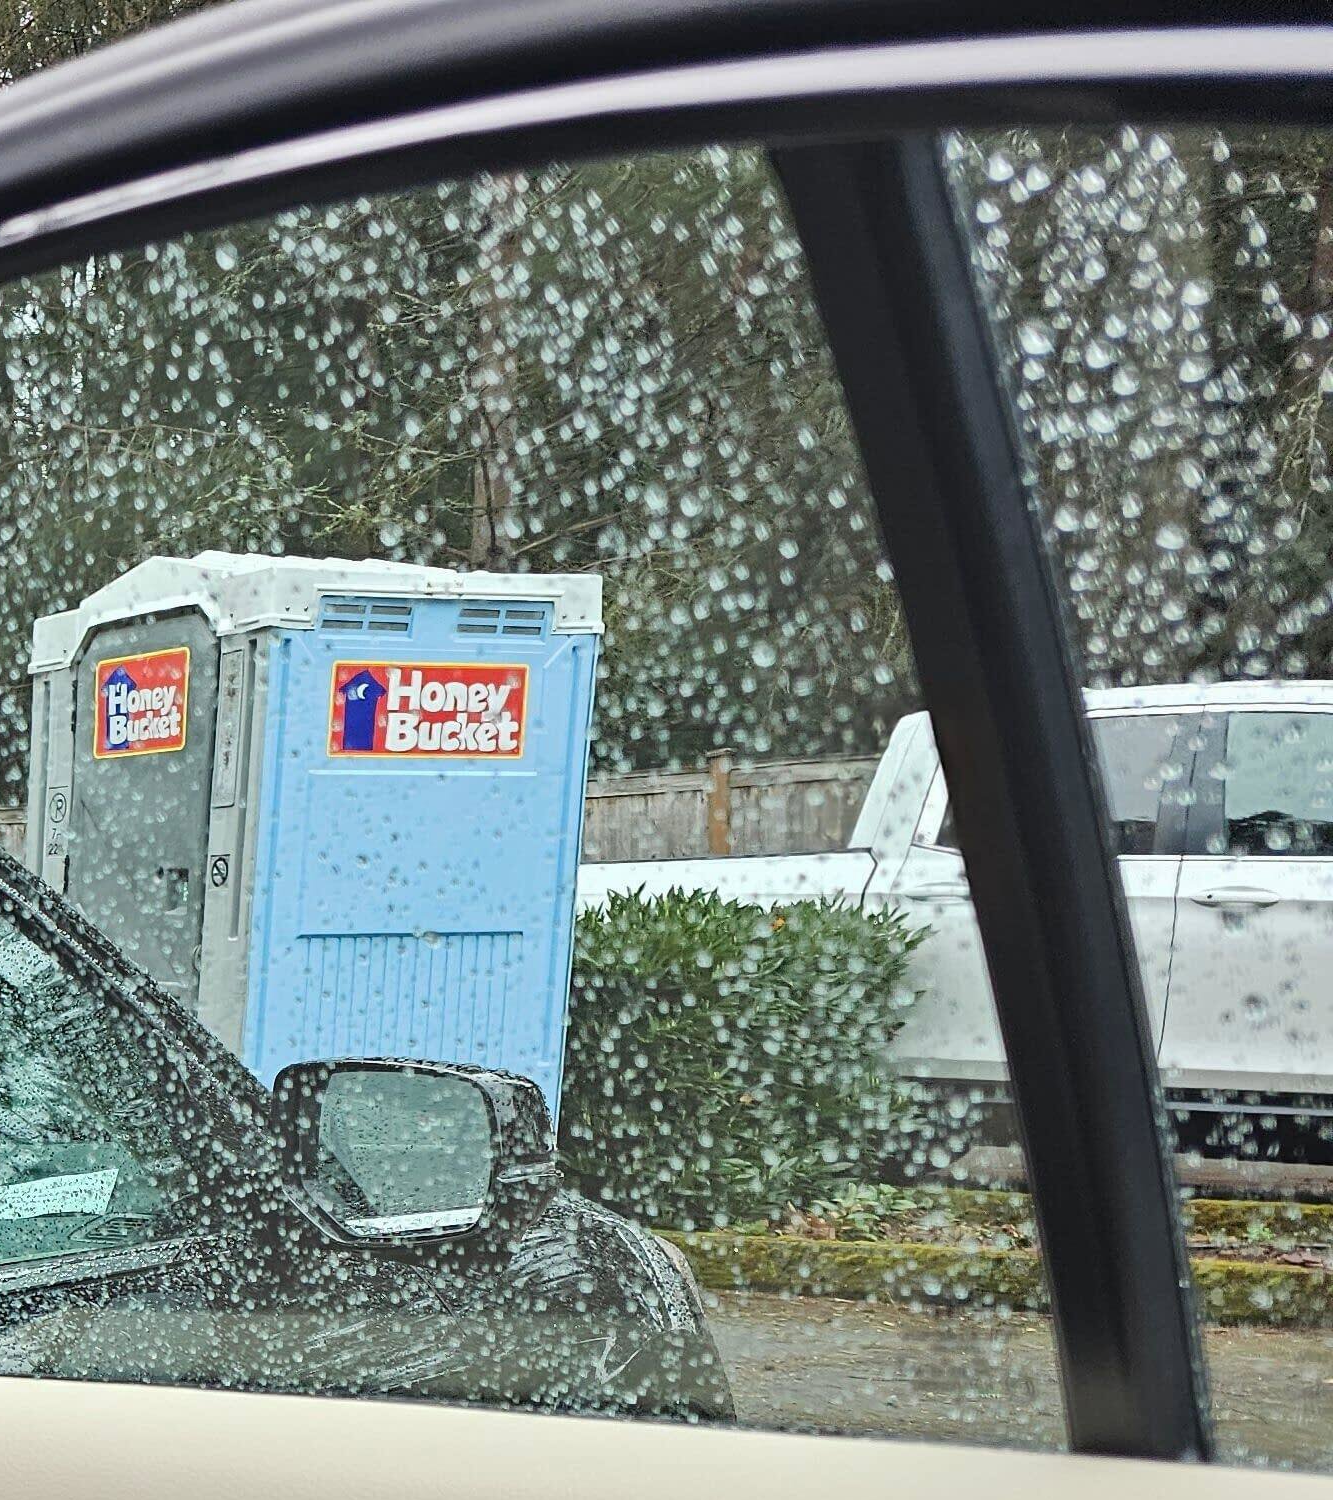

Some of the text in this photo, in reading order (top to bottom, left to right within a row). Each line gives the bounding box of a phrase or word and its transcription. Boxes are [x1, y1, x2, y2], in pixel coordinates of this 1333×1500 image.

[108, 682, 177, 716] Honey
[386, 669, 511, 716] Honey
[109, 705, 181, 745] Bucket
[385, 711, 519, 752] Bucket
